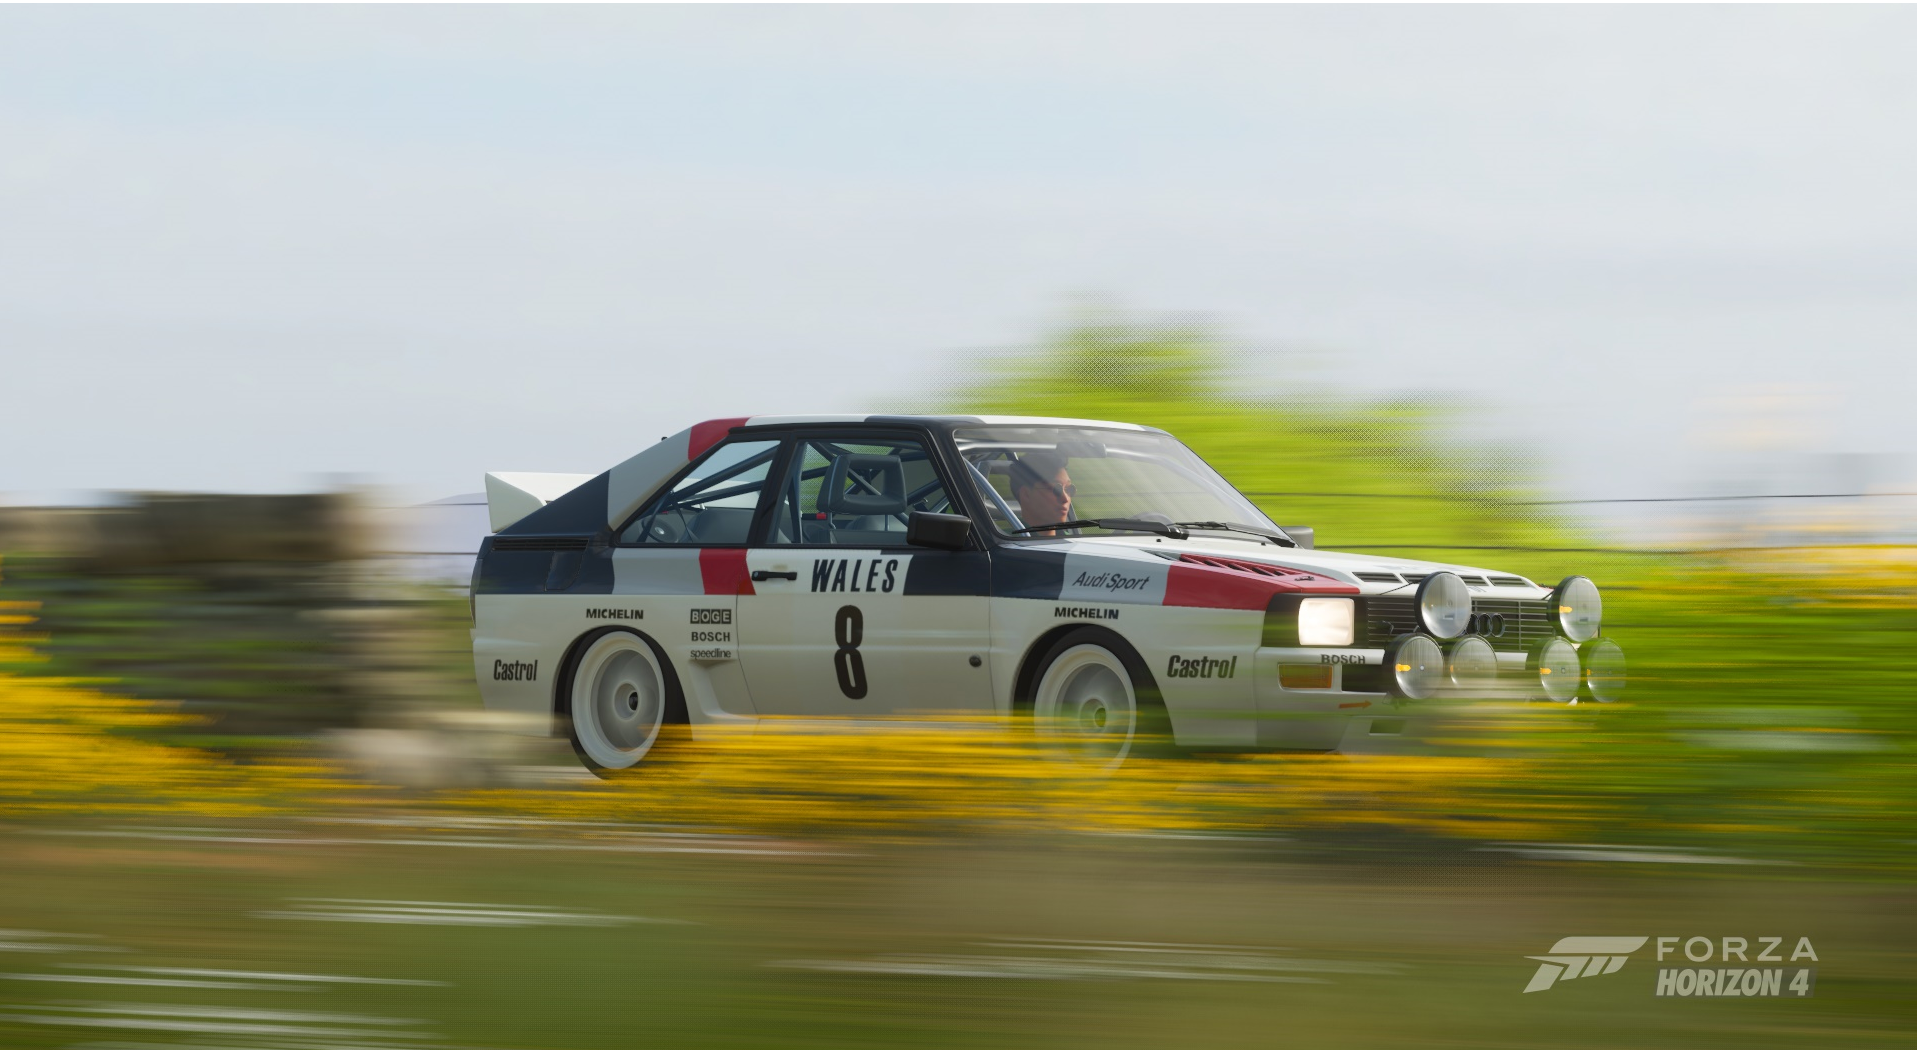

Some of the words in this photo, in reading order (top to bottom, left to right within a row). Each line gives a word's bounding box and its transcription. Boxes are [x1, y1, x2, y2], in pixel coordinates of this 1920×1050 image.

[811, 559, 899, 593] WALES
[1072, 571, 1110, 588] Audi
[1105, 573, 1150, 593] Sport
[586, 608, 644, 620] MICHELIN
[690, 609, 732, 624] BOGE
[1054, 607, 1119, 619] MICHELIN
[691, 631, 731, 642] BOSCH
[690, 648, 732, 661] speedline
[834, 604, 868, 700] 8
[1321, 654, 1366, 665] BOSCH
[493, 659, 538, 681] Castrol
[1167, 655, 1237, 679] Castrol
